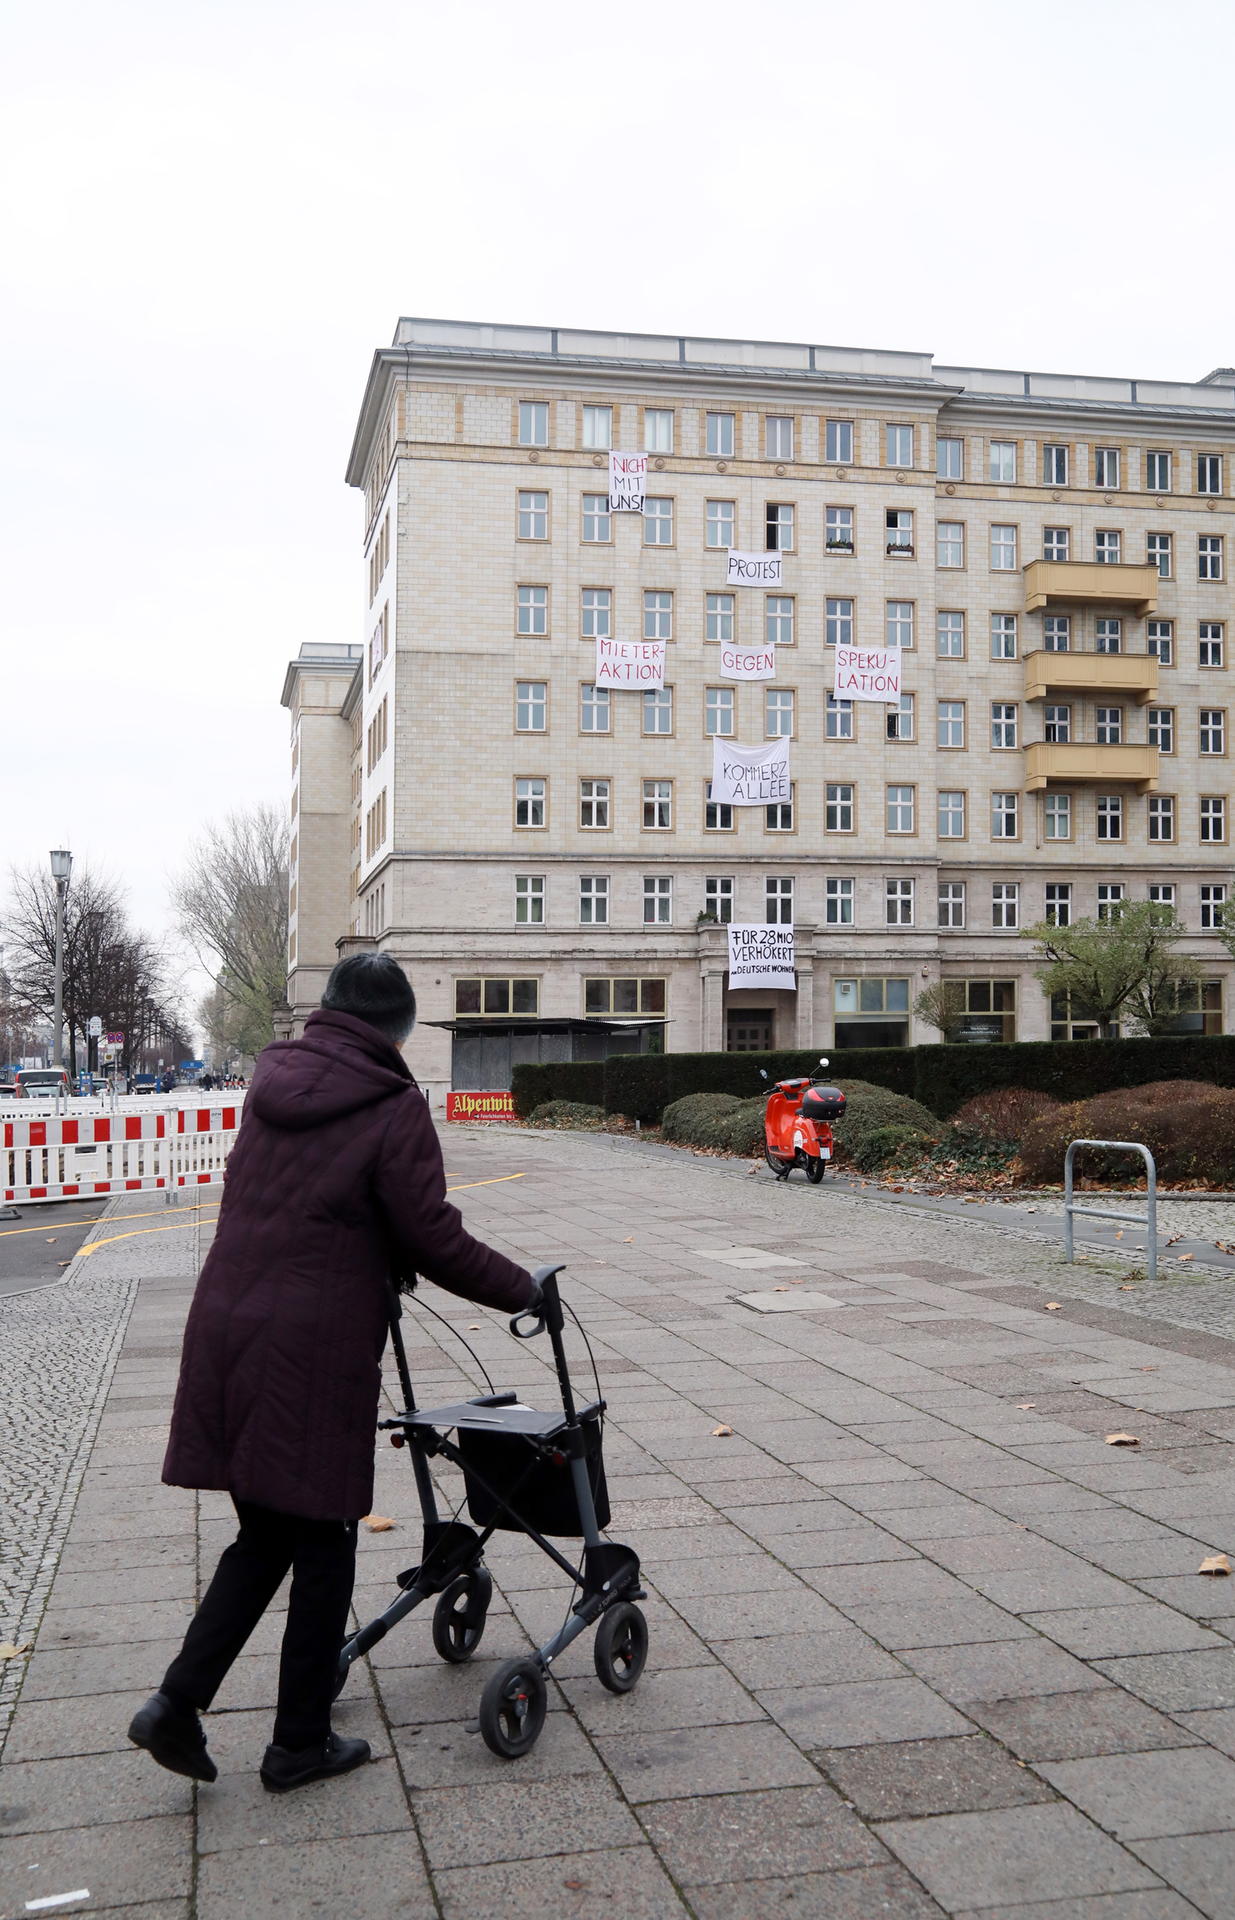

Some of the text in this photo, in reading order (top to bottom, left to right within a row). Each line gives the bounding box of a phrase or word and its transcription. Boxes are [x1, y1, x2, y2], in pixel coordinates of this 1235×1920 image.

[614, 476, 643, 491] MIT
[610, 494, 645, 511] UNS!
[728, 557, 782, 579] PROTEST
[600, 640, 665, 660] MIETER-
[722, 651, 773, 671] GEGEN
[599, 662, 662, 680] AKTION
[838, 672, 898, 692] LATION
[723, 761, 789, 782] KOMMERZ
[732, 779, 787, 800] ALLEE
[731, 929, 794, 945] FÜR 28 MIO
[732, 945, 794, 962] VERHÖKERT
[737, 965, 771, 975] DEUTSCHE
